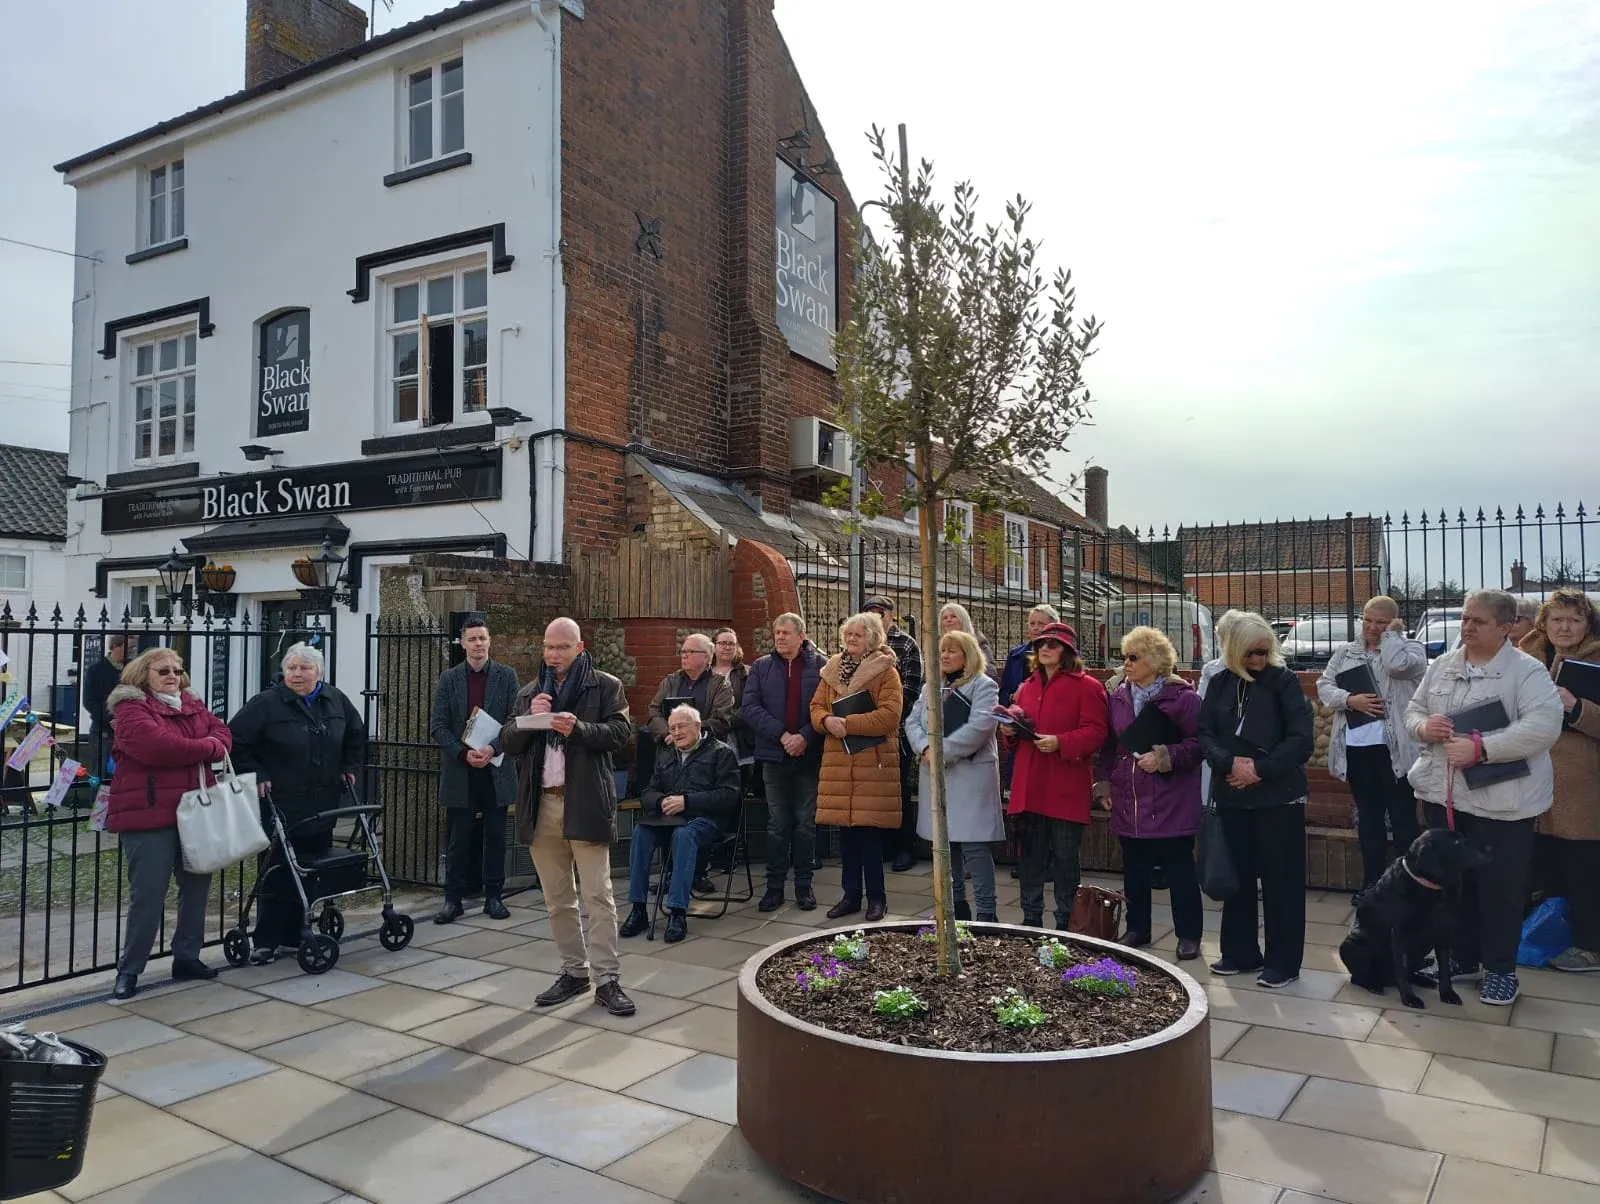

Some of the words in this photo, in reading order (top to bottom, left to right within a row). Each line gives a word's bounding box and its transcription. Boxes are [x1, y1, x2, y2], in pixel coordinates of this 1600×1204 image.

[776, 227, 828, 296] Black
[776, 268, 829, 330] Swan
[263, 359, 311, 391] Black
[261, 391, 310, 417] Swan
[387, 470, 443, 485] TRADITIONAL
[444, 467, 462, 480] PUB
[201, 480, 271, 519] Black
[277, 478, 351, 512] Swan
